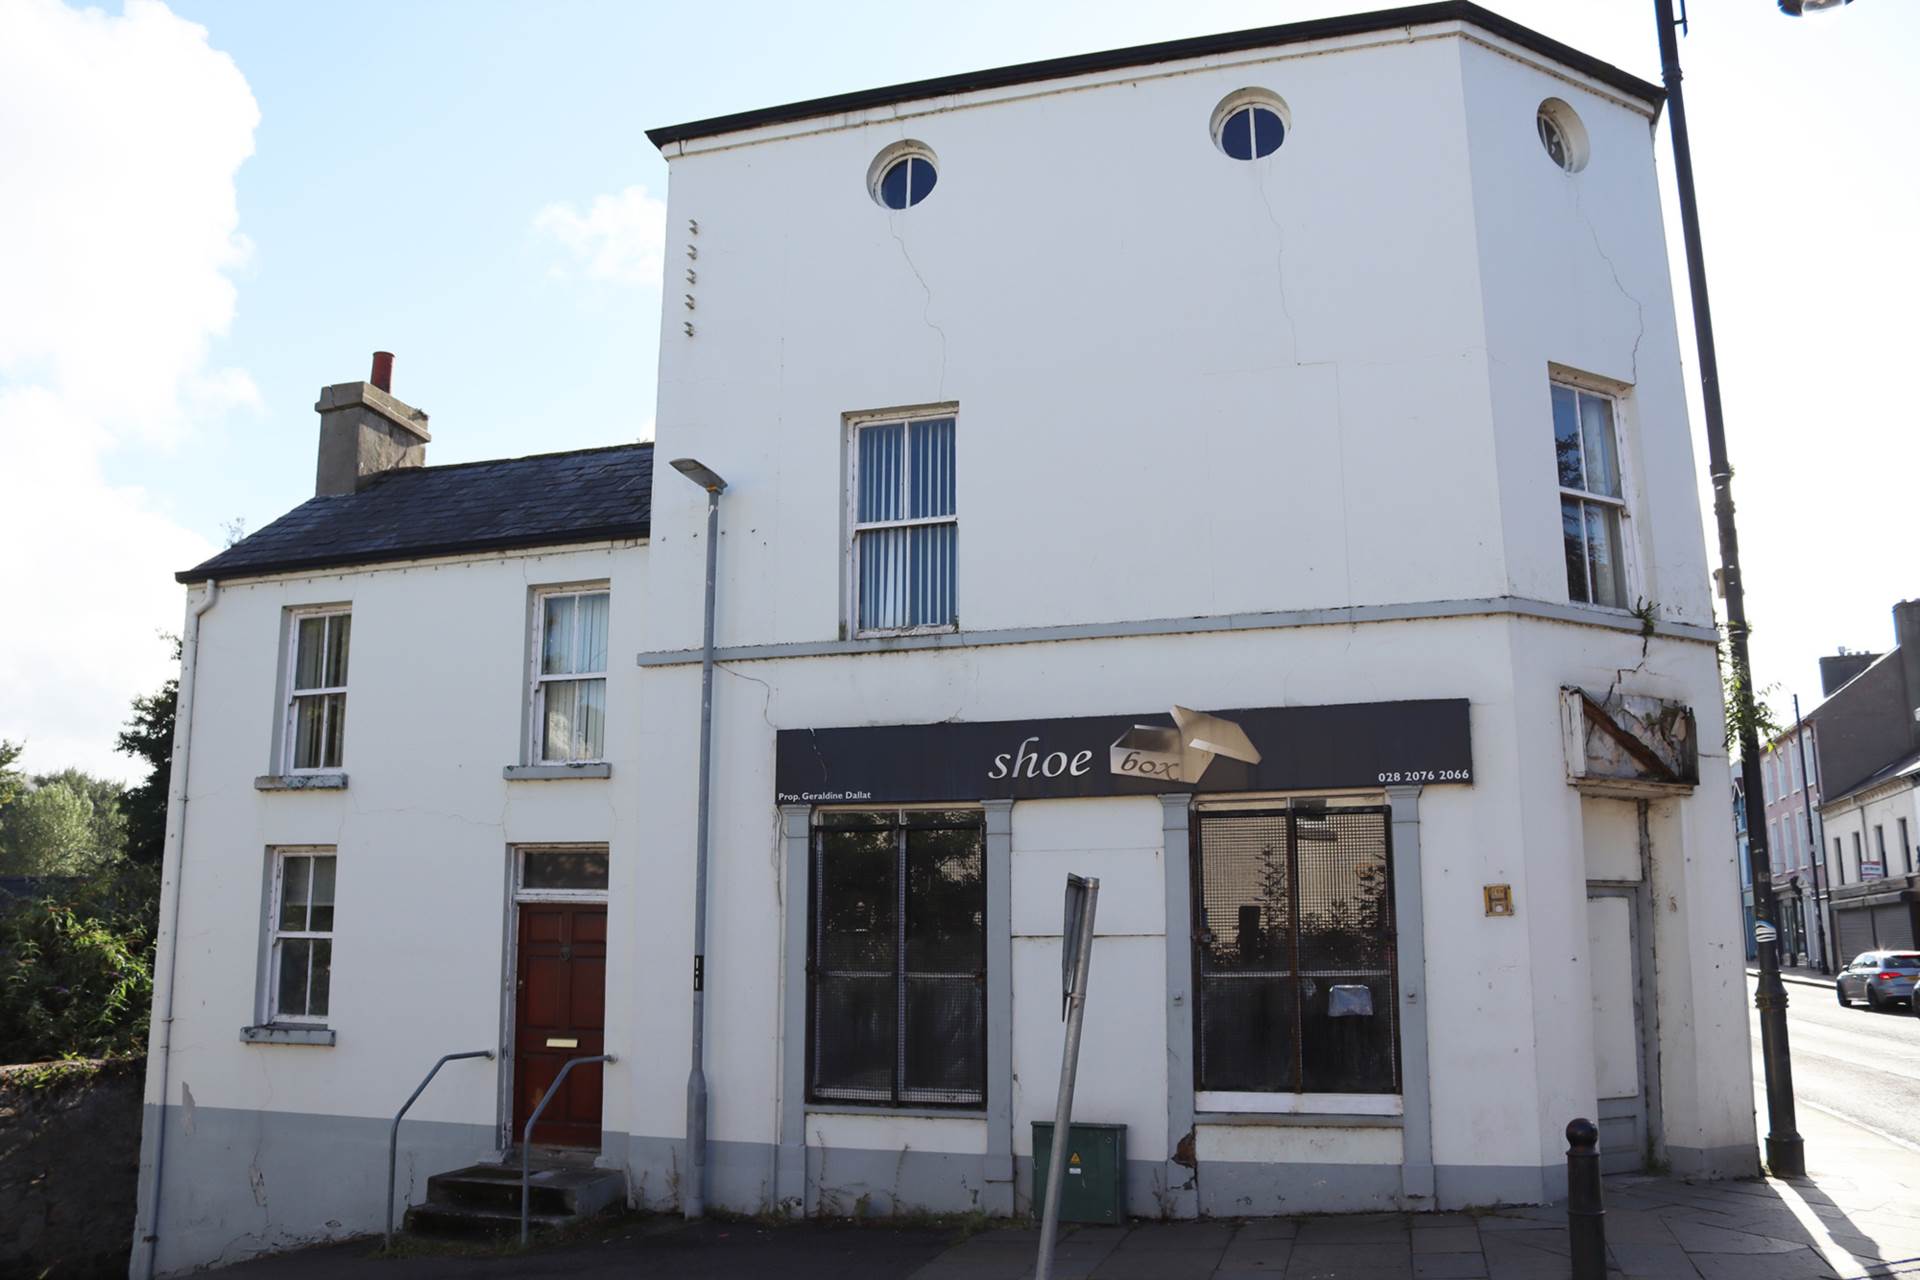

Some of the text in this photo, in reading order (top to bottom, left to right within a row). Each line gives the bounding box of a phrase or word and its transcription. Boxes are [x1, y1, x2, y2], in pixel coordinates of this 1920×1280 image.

[987, 736, 1179, 781] shoe box
[1378, 769, 1469, 782] 028 2076 2066
[778, 790, 871, 802] Prop. Geraldine Dallat
